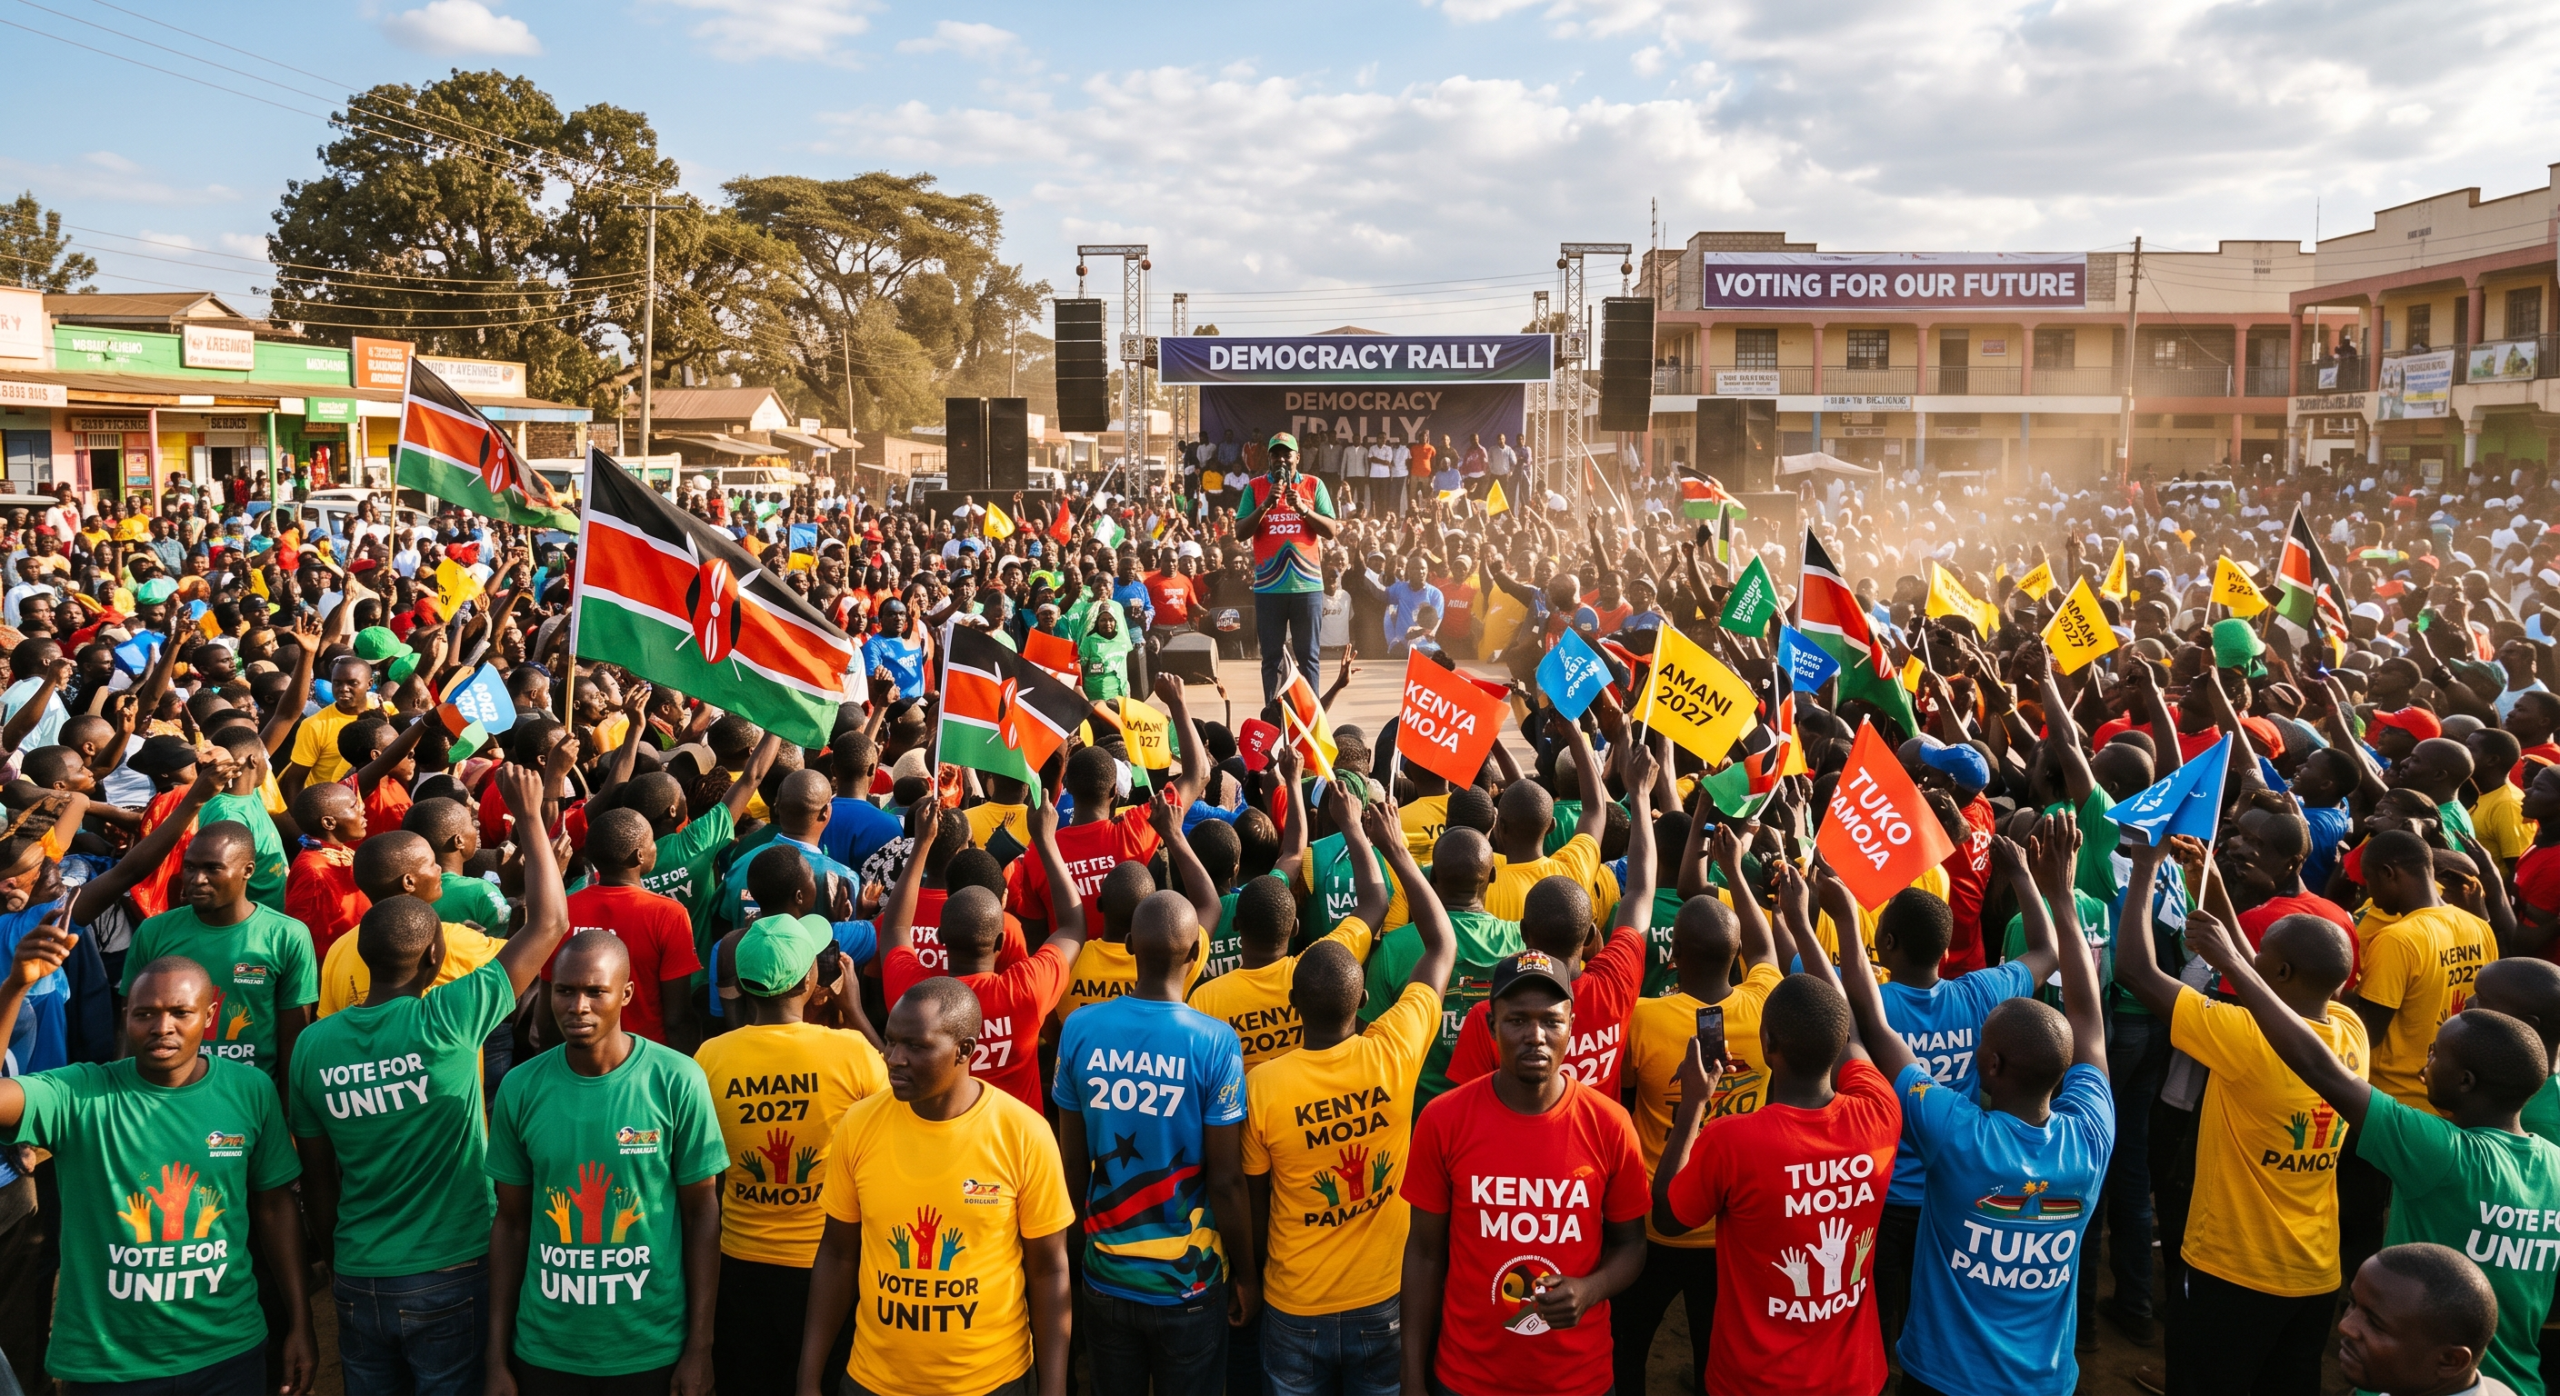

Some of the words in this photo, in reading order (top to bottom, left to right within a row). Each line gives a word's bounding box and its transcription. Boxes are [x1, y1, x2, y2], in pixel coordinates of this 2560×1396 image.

[1715, 273, 1822, 297] VOTING
[1830, 273, 1888, 298] FOR
[1894, 273, 1956, 298] OUR
[1964, 272, 2076, 297] FUTURE
[1209, 344, 1399, 370] DEMOCRACY
[1408, 344, 1501, 369] RALLY
[1285, 391, 1443, 411] DEMOCRACY
[1269, 524, 1302, 535] 2027
[1405, 679, 1476, 736] KENYA
[1656, 685, 1714, 727] 2027
[1658, 662, 1733, 717] AMANI
[1401, 705, 1459, 754] MOJA
[1848, 765, 1912, 846] TUKO
[218, 1043, 256, 1058] FOR
[1240, 1024, 1304, 1056] 2027
[320, 1061, 377, 1087] VOTE
[378, 1052, 425, 1080] FOR
[1086, 1047, 1186, 1081] AMANI
[325, 1074, 429, 1120] UNITY
[725, 1072, 819, 1099] AMANI
[1086, 1076, 1186, 1117] 2027
[738, 1099, 810, 1124] 2027
[1294, 1085, 1391, 1127] KENYA
[1304, 1110, 1389, 1150] MOJA
[1784, 1153, 1874, 1189] TUKO
[2260, 1149, 2342, 1173] PAMOJ
[1304, 1184, 1393, 1228] PAMOJA
[1471, 1175, 1590, 1208] KENYA
[1785, 1181, 1875, 1218] MOJA
[1480, 1208, 1582, 1244] MOJA
[2480, 1200, 2541, 1232] VOTE
[108, 1243, 175, 1268] VOTE
[181, 1239, 228, 1266] FOR
[541, 1243, 595, 1270] VOTE
[602, 1245, 651, 1269] FOR
[1963, 1219, 2077, 1264] TUKO
[108, 1262, 229, 1303] UNITY
[541, 1268, 651, 1306] UNITY
[878, 1269, 928, 1298] VOTE
[935, 1277, 979, 1299] FOR
[1950, 1248, 2070, 1290] PAMOJA
[877, 1295, 979, 1333] UNITY
